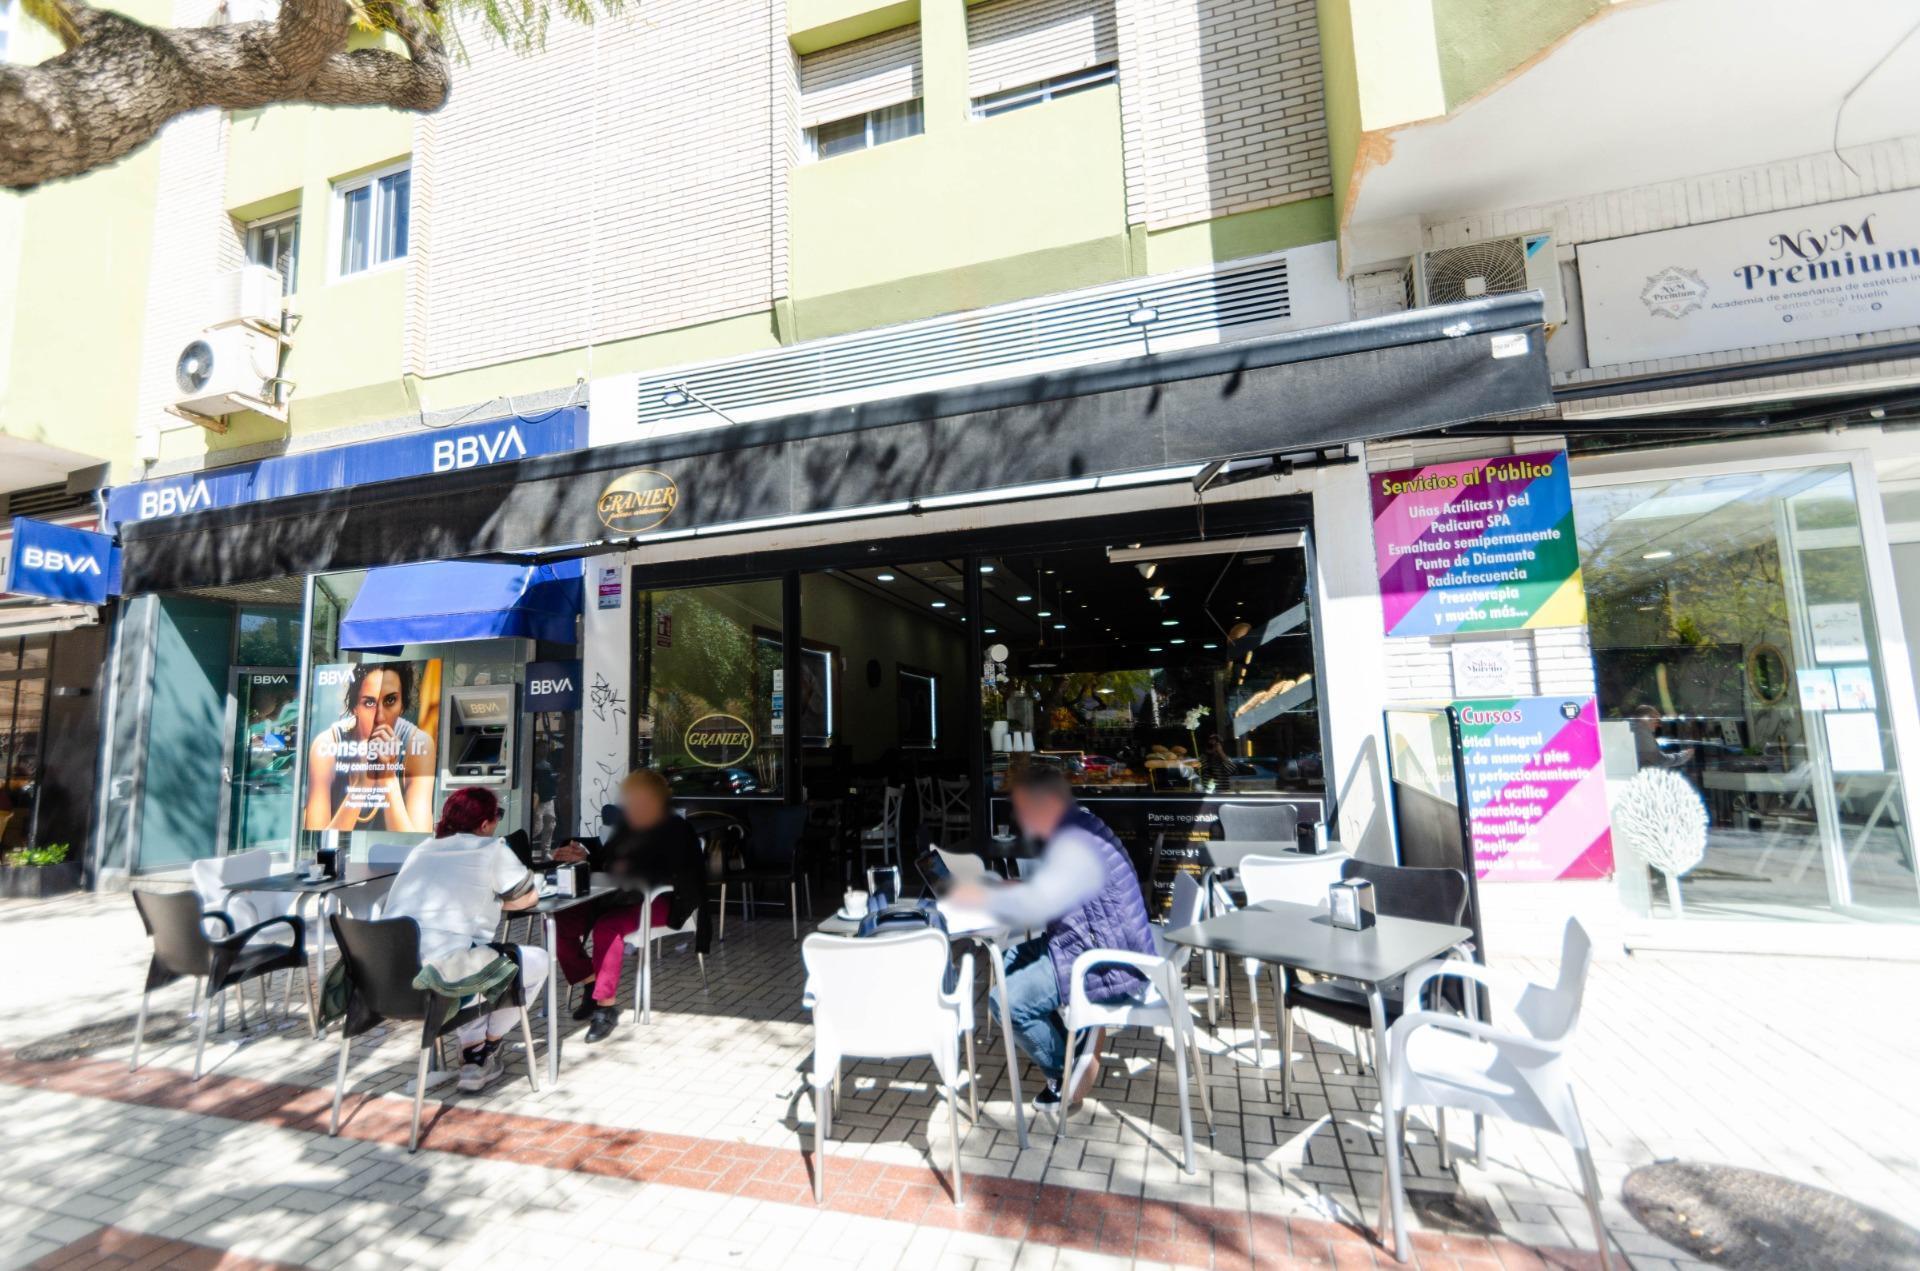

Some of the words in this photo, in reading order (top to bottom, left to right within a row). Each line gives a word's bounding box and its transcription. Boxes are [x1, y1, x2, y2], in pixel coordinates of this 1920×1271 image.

[1769, 213, 1876, 262] NyM
[1733, 247, 1920, 290] Premium
[1710, 295, 1764, 310] Academia
[1766, 292, 1781, 302] de
[1782, 286, 1842, 299] enseñanza
[1845, 281, 1859, 291] de
[1862, 275, 1908, 288] estética
[1774, 300, 1811, 312] Centro
[1813, 295, 1848, 306] Oficial
[1850, 289, 1889, 302] Huelin
[433, 425, 527, 473] BBVA
[1382, 473, 1457, 496] Servicios
[1463, 467, 1480, 486] al
[1486, 461, 1553, 483] Público
[140, 482, 211, 519] BBVA
[600, 486, 675, 513] GRANIER
[1408, 505, 1440, 518] Uñas
[1442, 499, 1494, 514] Acrílicas
[1497, 499, 1504, 512] y
[1507, 492, 1530, 507] Gel
[1431, 520, 1484, 533] Pedicura
[1487, 514, 1511, 527] SPA
[1388, 539, 1451, 556] Esmaltado
[1454, 529, 1561, 549] semipermanente
[23, 547, 101, 575] BBVA
[1415, 557, 1450, 571] Punta
[1454, 555, 1470, 567] de
[1473, 550, 1536, 566] Diamante
[1426, 568, 1527, 588] Radiofrecuencia
[1439, 587, 1520, 605] Presoterapia
[1434, 613, 1443, 626] y
[1446, 607, 1487, 622] mucho
[253, 675, 288, 684] BBVA
[318, 667, 355, 685] BBVA
[530, 678, 574, 695] BBVA
[470, 702, 500, 714] BBVA
[1461, 707, 1522, 725] Cursos
[317, 737, 406, 761] conseguir.
[688, 732, 750, 749] GRANIER
[1494, 731, 1543, 748] Integral
[1473, 751, 1488, 765] de
[1490, 753, 1531, 765] manos
[1532, 753, 1542, 766] y
[1543, 750, 1571, 766] pies
[335, 762, 350, 774] Hoy
[351, 762, 385, 771] comienza
[1468, 772, 1477, 785] y
[1478, 767, 1591, 784] perfeccionamiento
[1472, 786, 1491, 802] gel
[1493, 789, 1502, 802] y
[1504, 784, 1548, 799] acrílico
[1148, 813, 1175, 822] Panes
